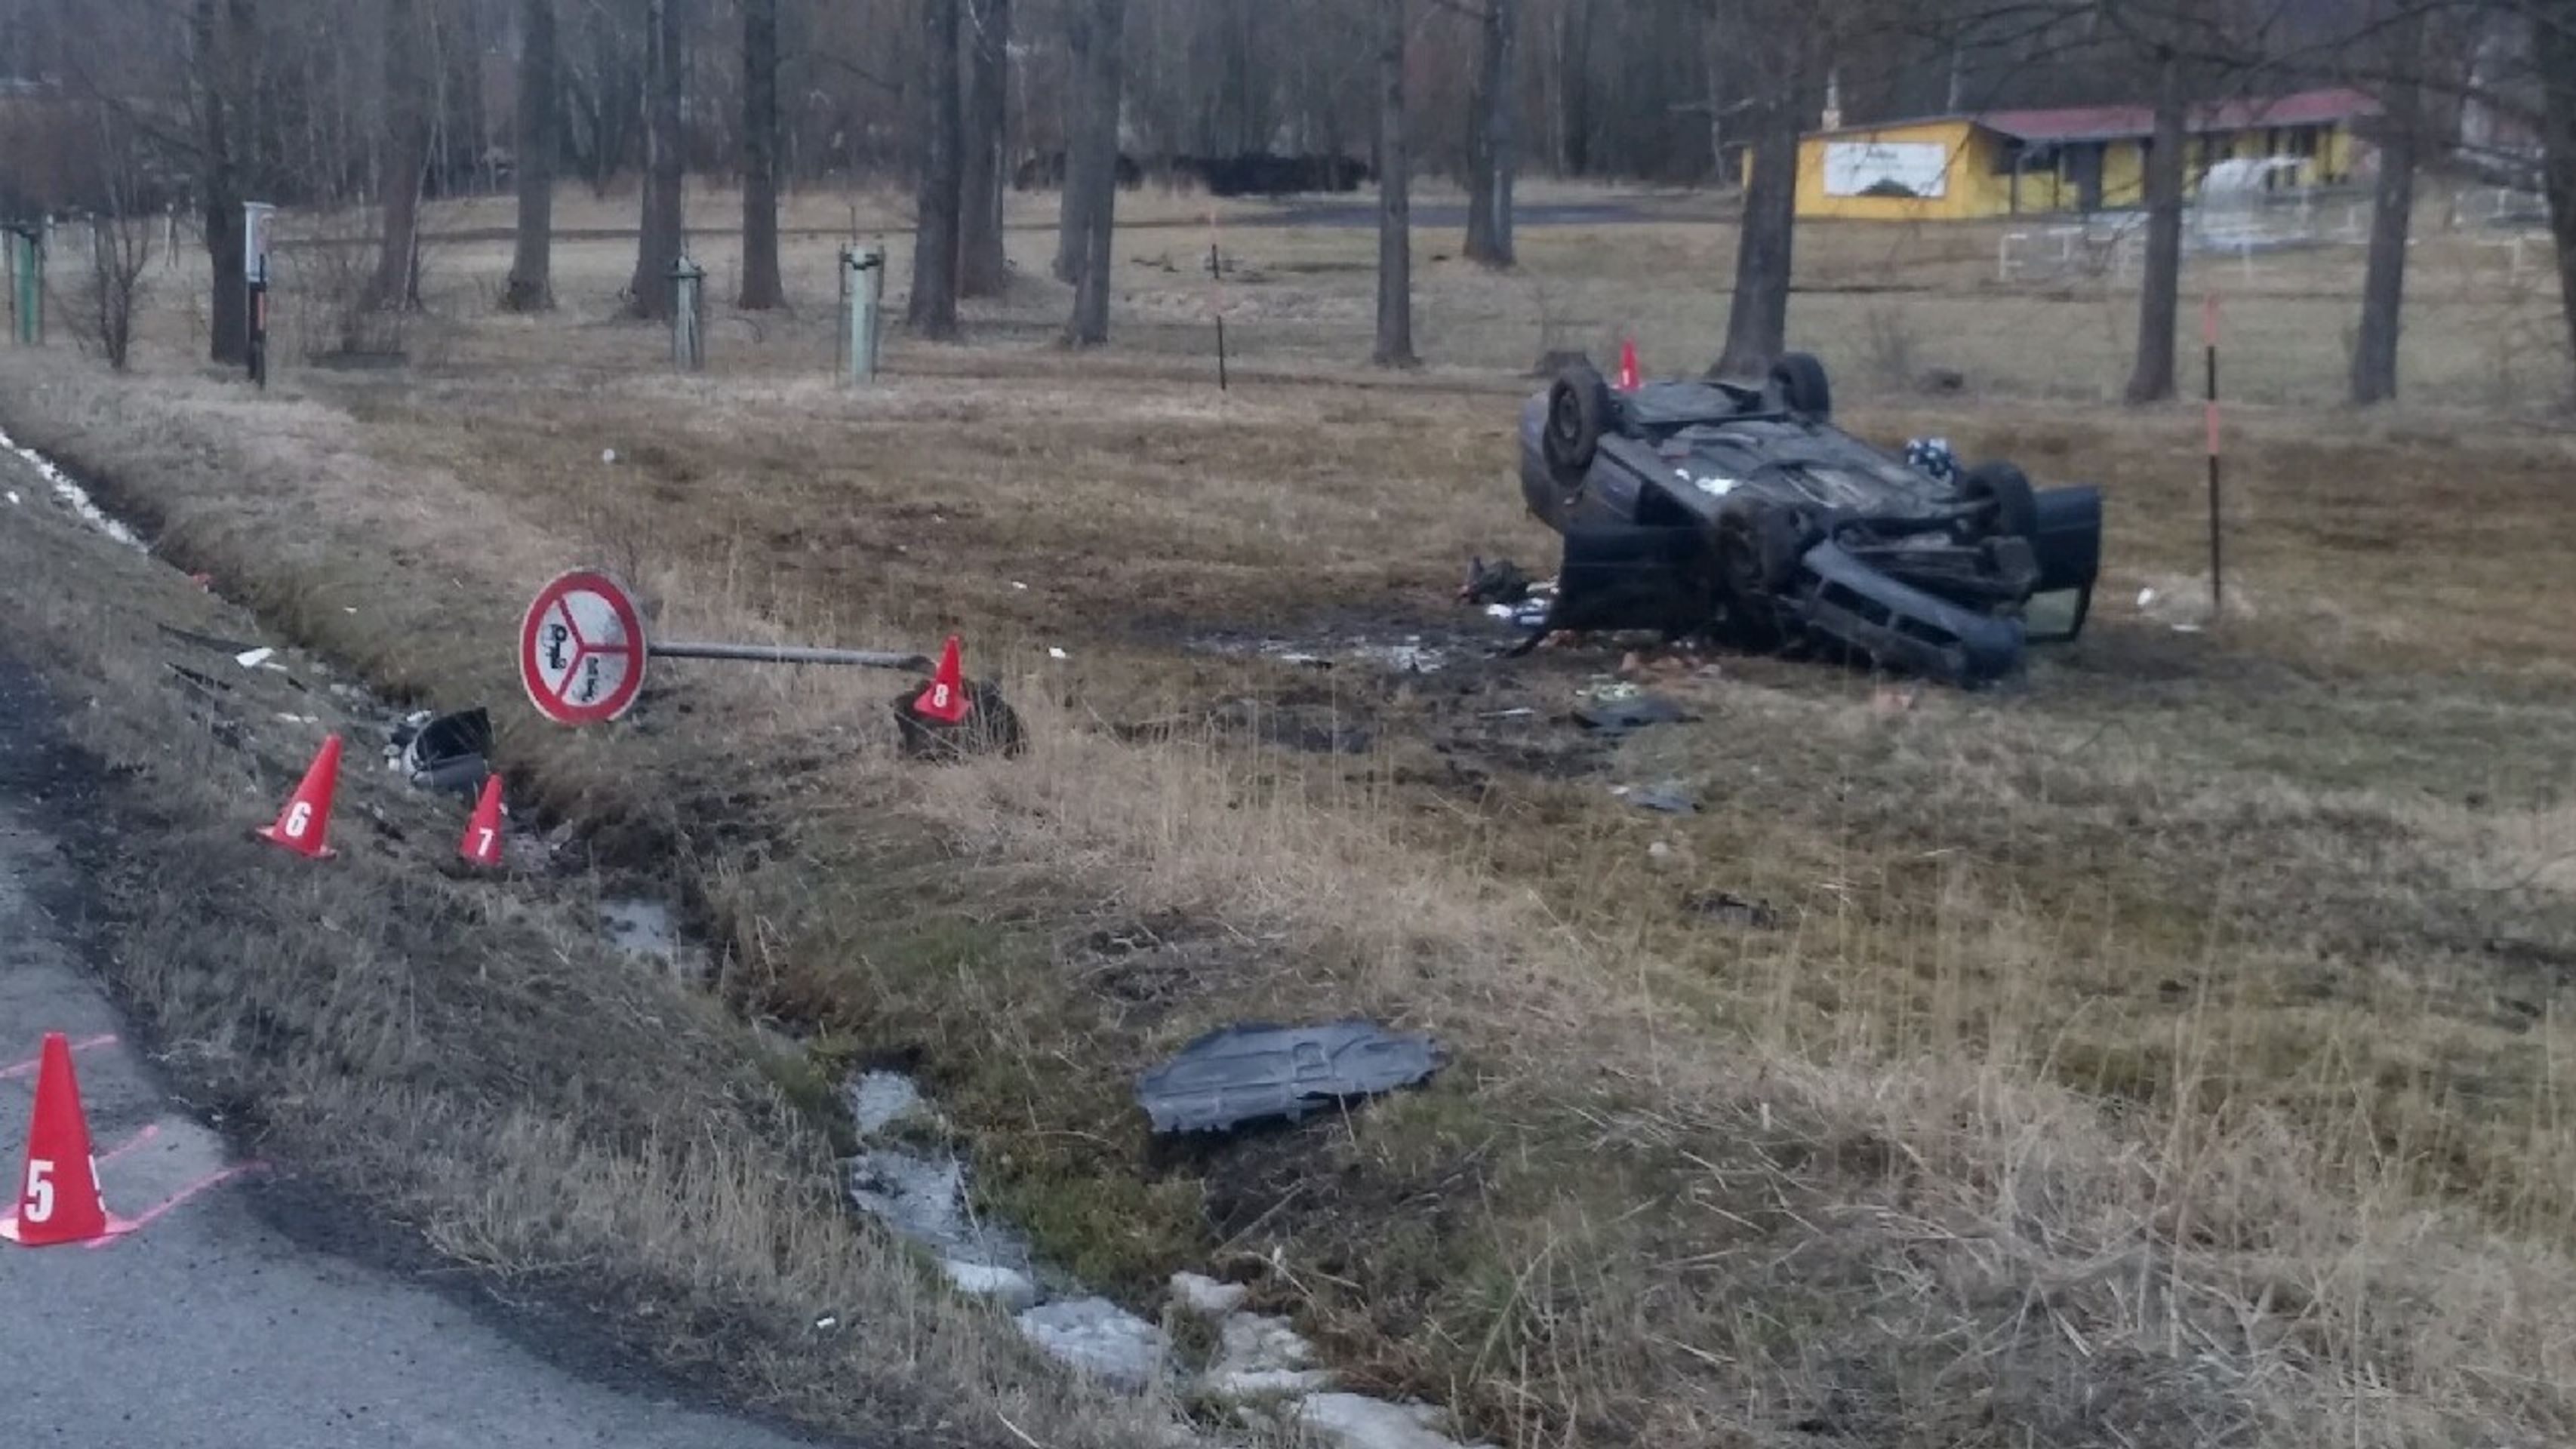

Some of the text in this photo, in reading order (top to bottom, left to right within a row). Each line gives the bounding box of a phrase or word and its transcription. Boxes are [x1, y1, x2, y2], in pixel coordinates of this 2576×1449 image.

[933, 684, 949, 708] 8
[285, 801, 312, 838] 6
[479, 827, 494, 856] 7
[24, 1159, 54, 1222] 5
